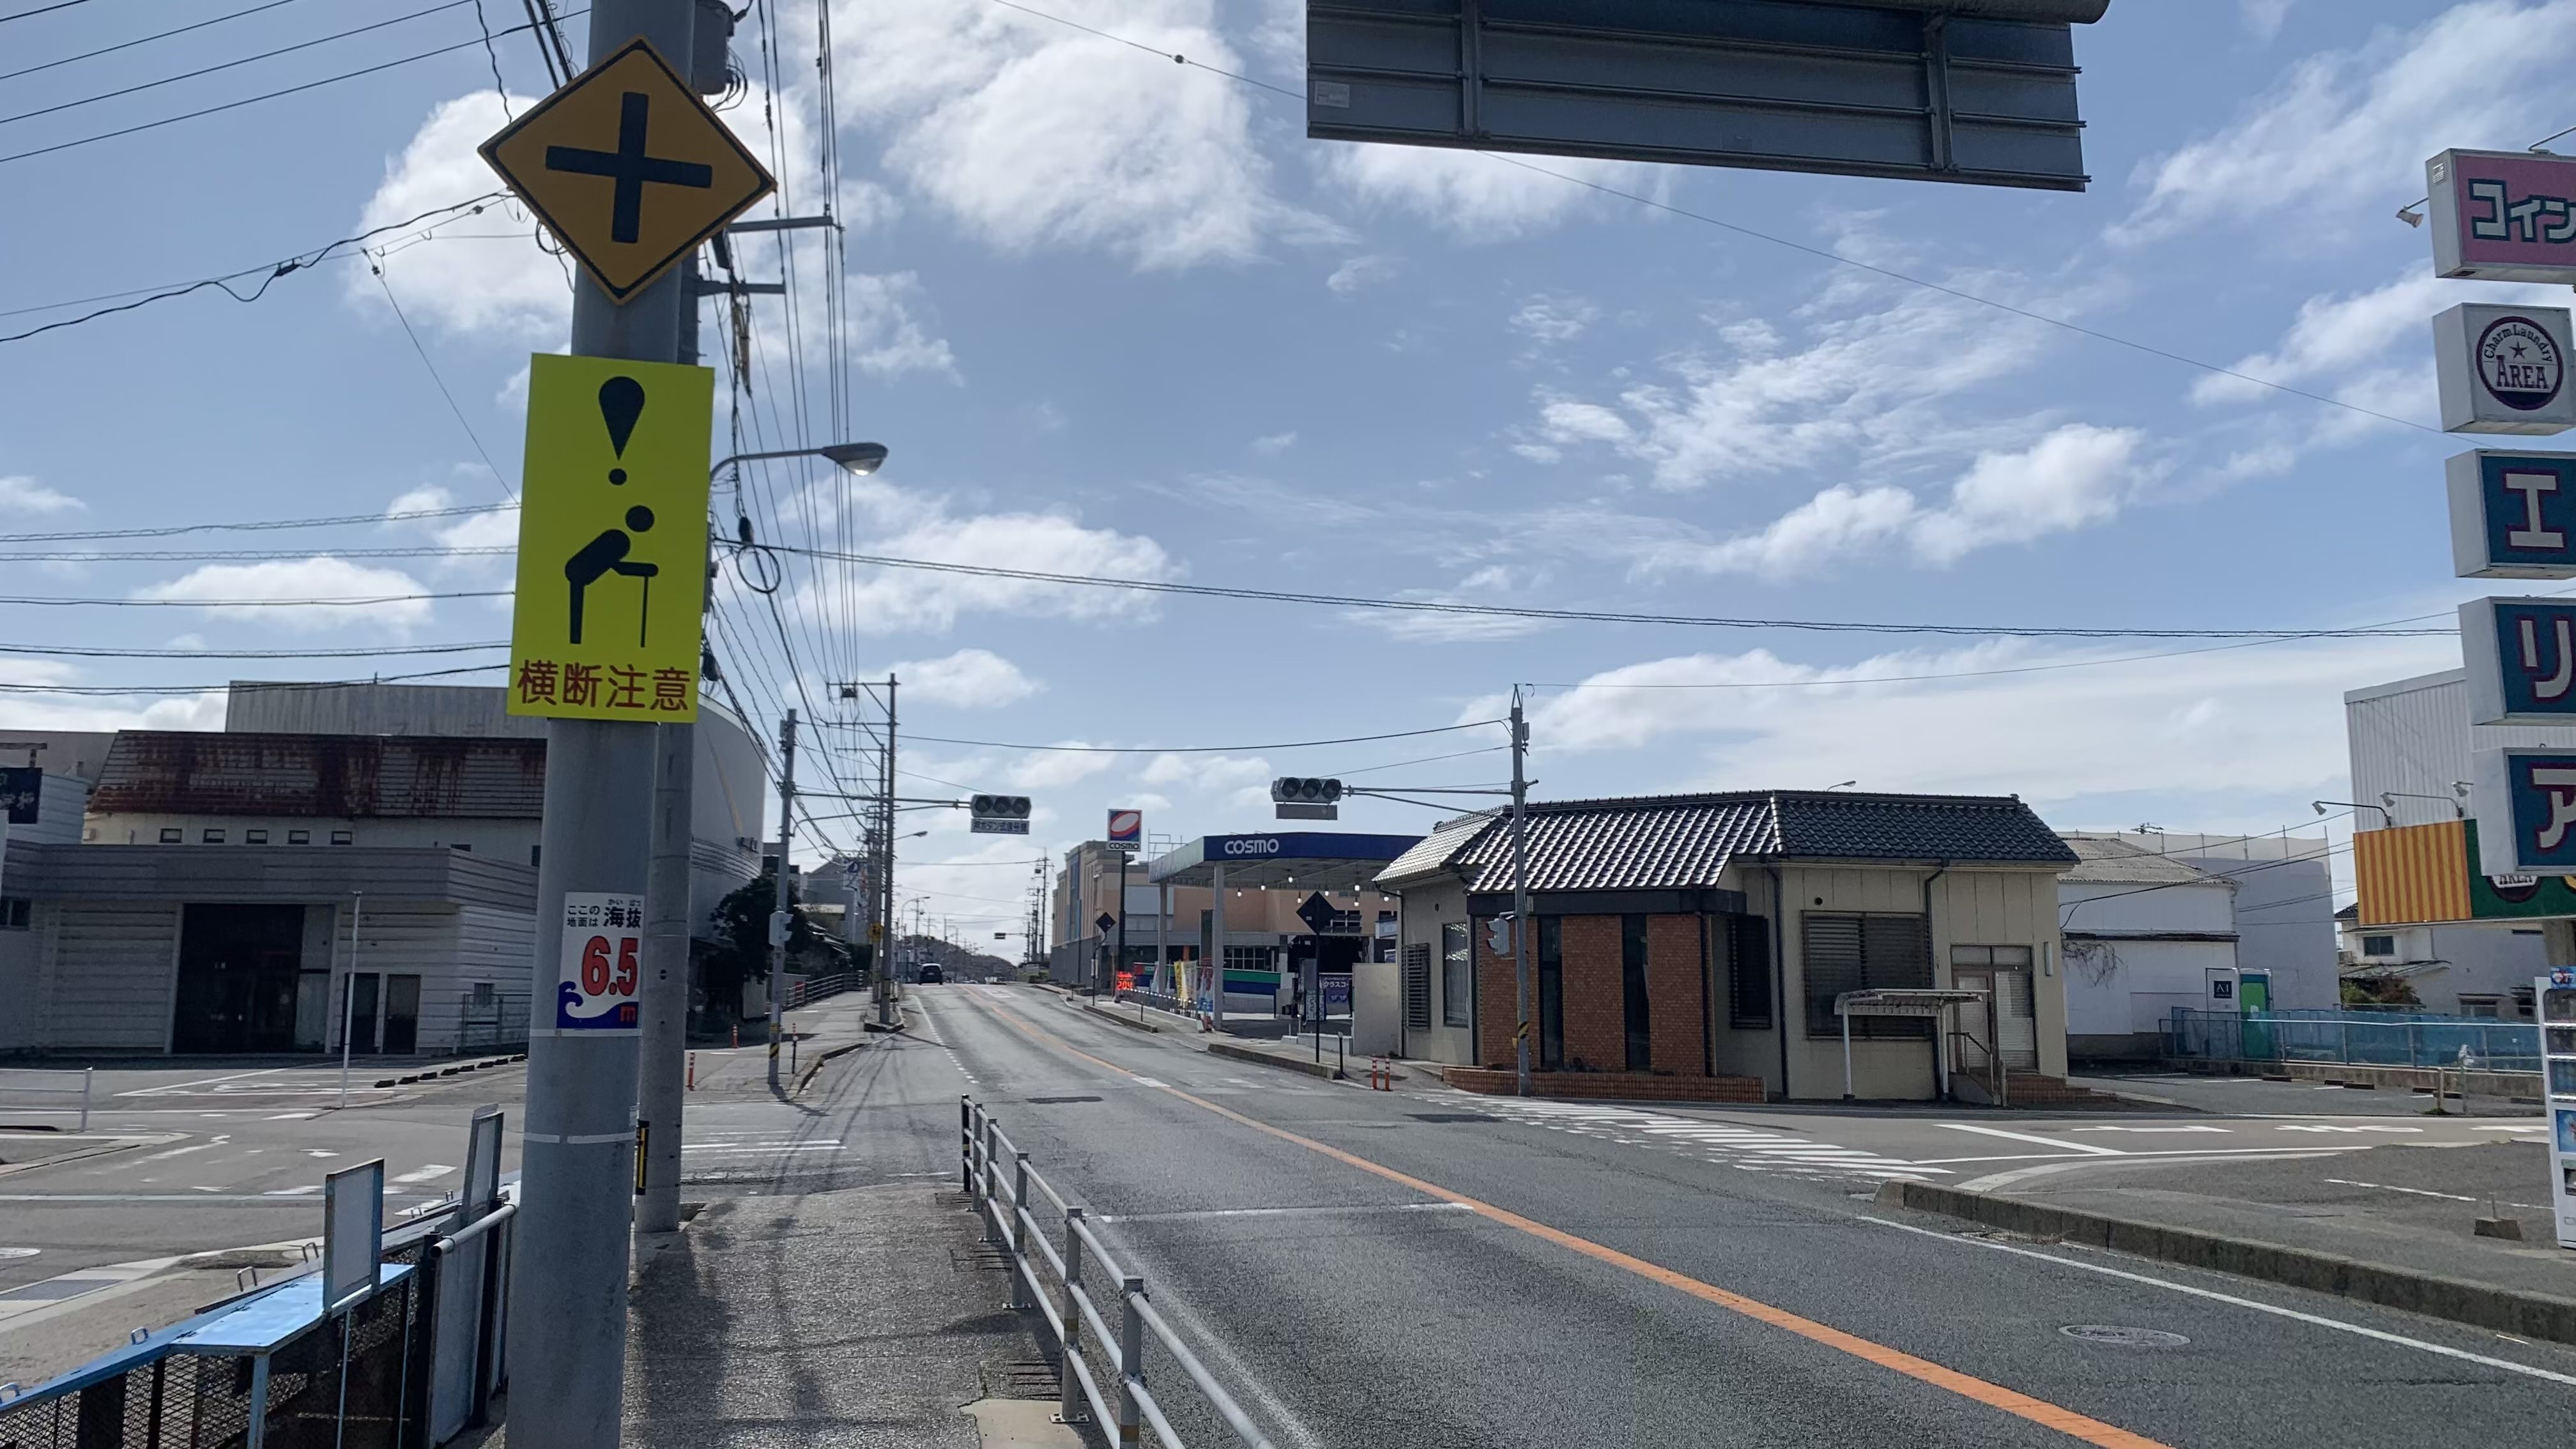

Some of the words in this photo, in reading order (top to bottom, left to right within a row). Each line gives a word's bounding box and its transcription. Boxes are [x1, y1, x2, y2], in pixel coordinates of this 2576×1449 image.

[2468, 178, 2576, 243] コイン
[2495, 355, 2549, 389] AREA
[517, 659, 691, 710] 横断注意
[1224, 838, 1279, 855] COSMO
[568, 905, 601, 915] ここの
[603, 906, 641, 928] 海抜
[567, 917, 599, 927] 地面は
[581, 935, 639, 997] 6.5
[620, 1006, 636, 1022] m
